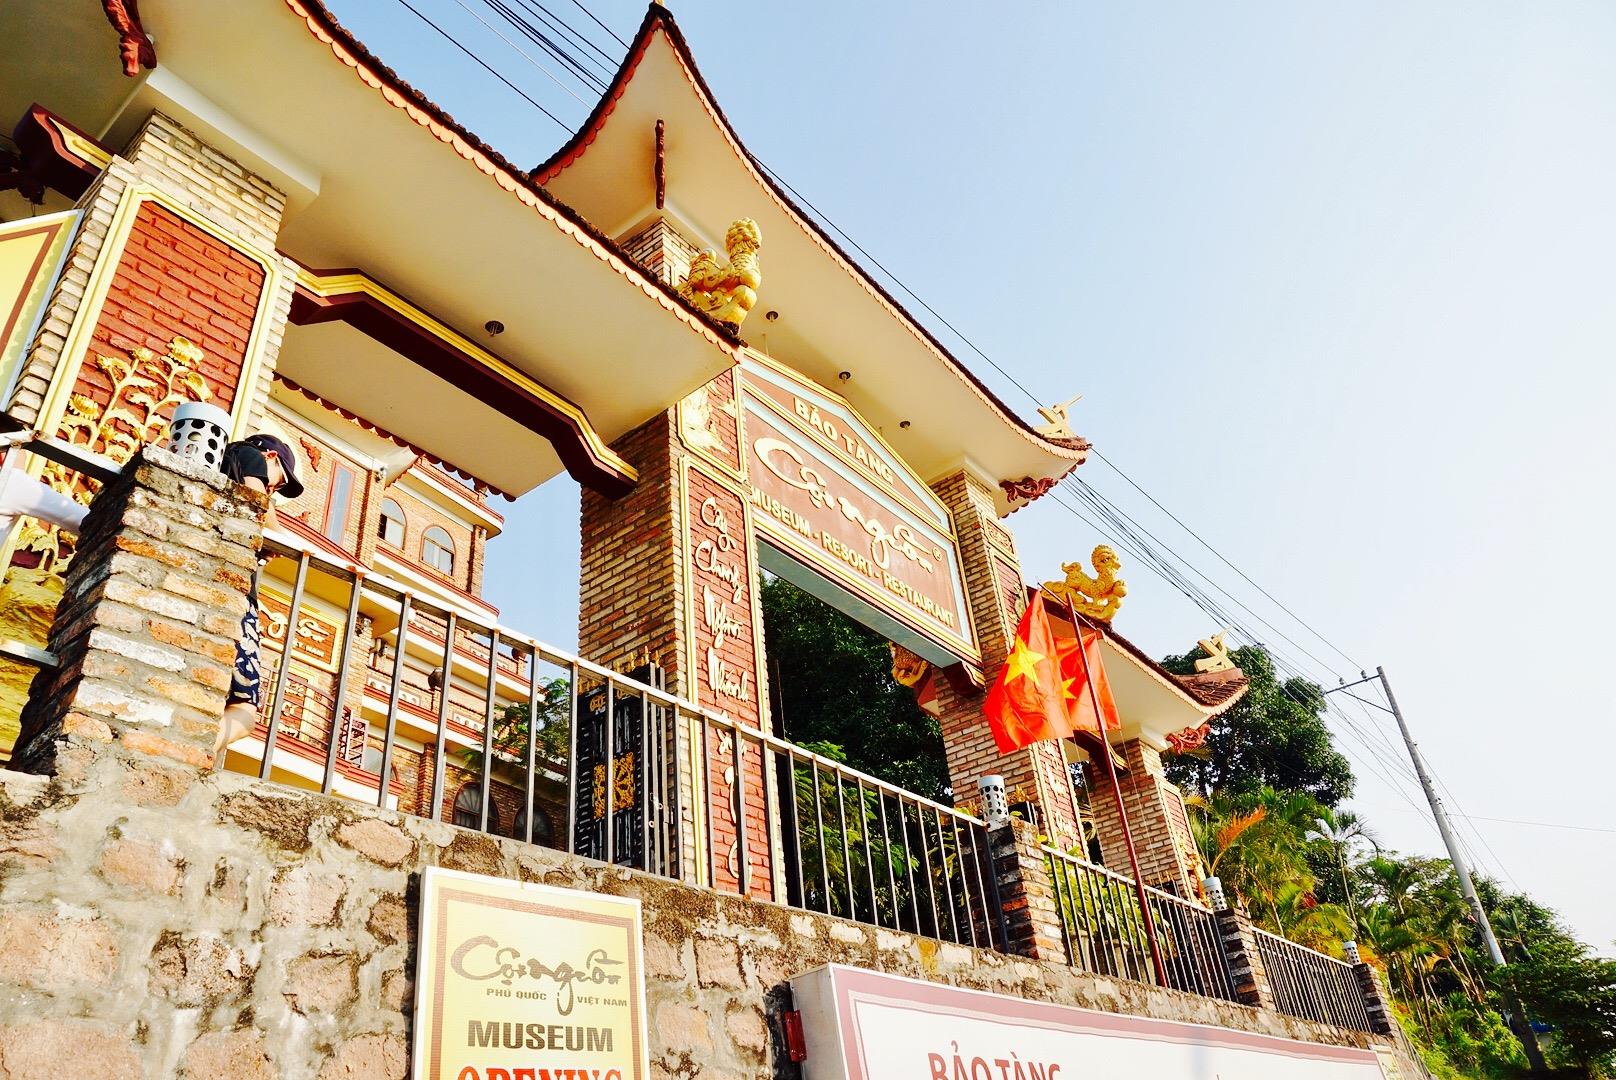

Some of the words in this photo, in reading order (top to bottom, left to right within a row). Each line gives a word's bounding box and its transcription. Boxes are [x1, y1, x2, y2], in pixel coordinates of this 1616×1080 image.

[794, 397, 838, 441] BẢO
[841, 432, 894, 485] TÀNG
[751, 485, 811, 538] MUSEUM
[820, 530, 873, 578] RESORT
[880, 569, 955, 628] RESTAURANT
[603, 998, 628, 1007] NAM
[467, 1019, 614, 1052] MUSEUM
